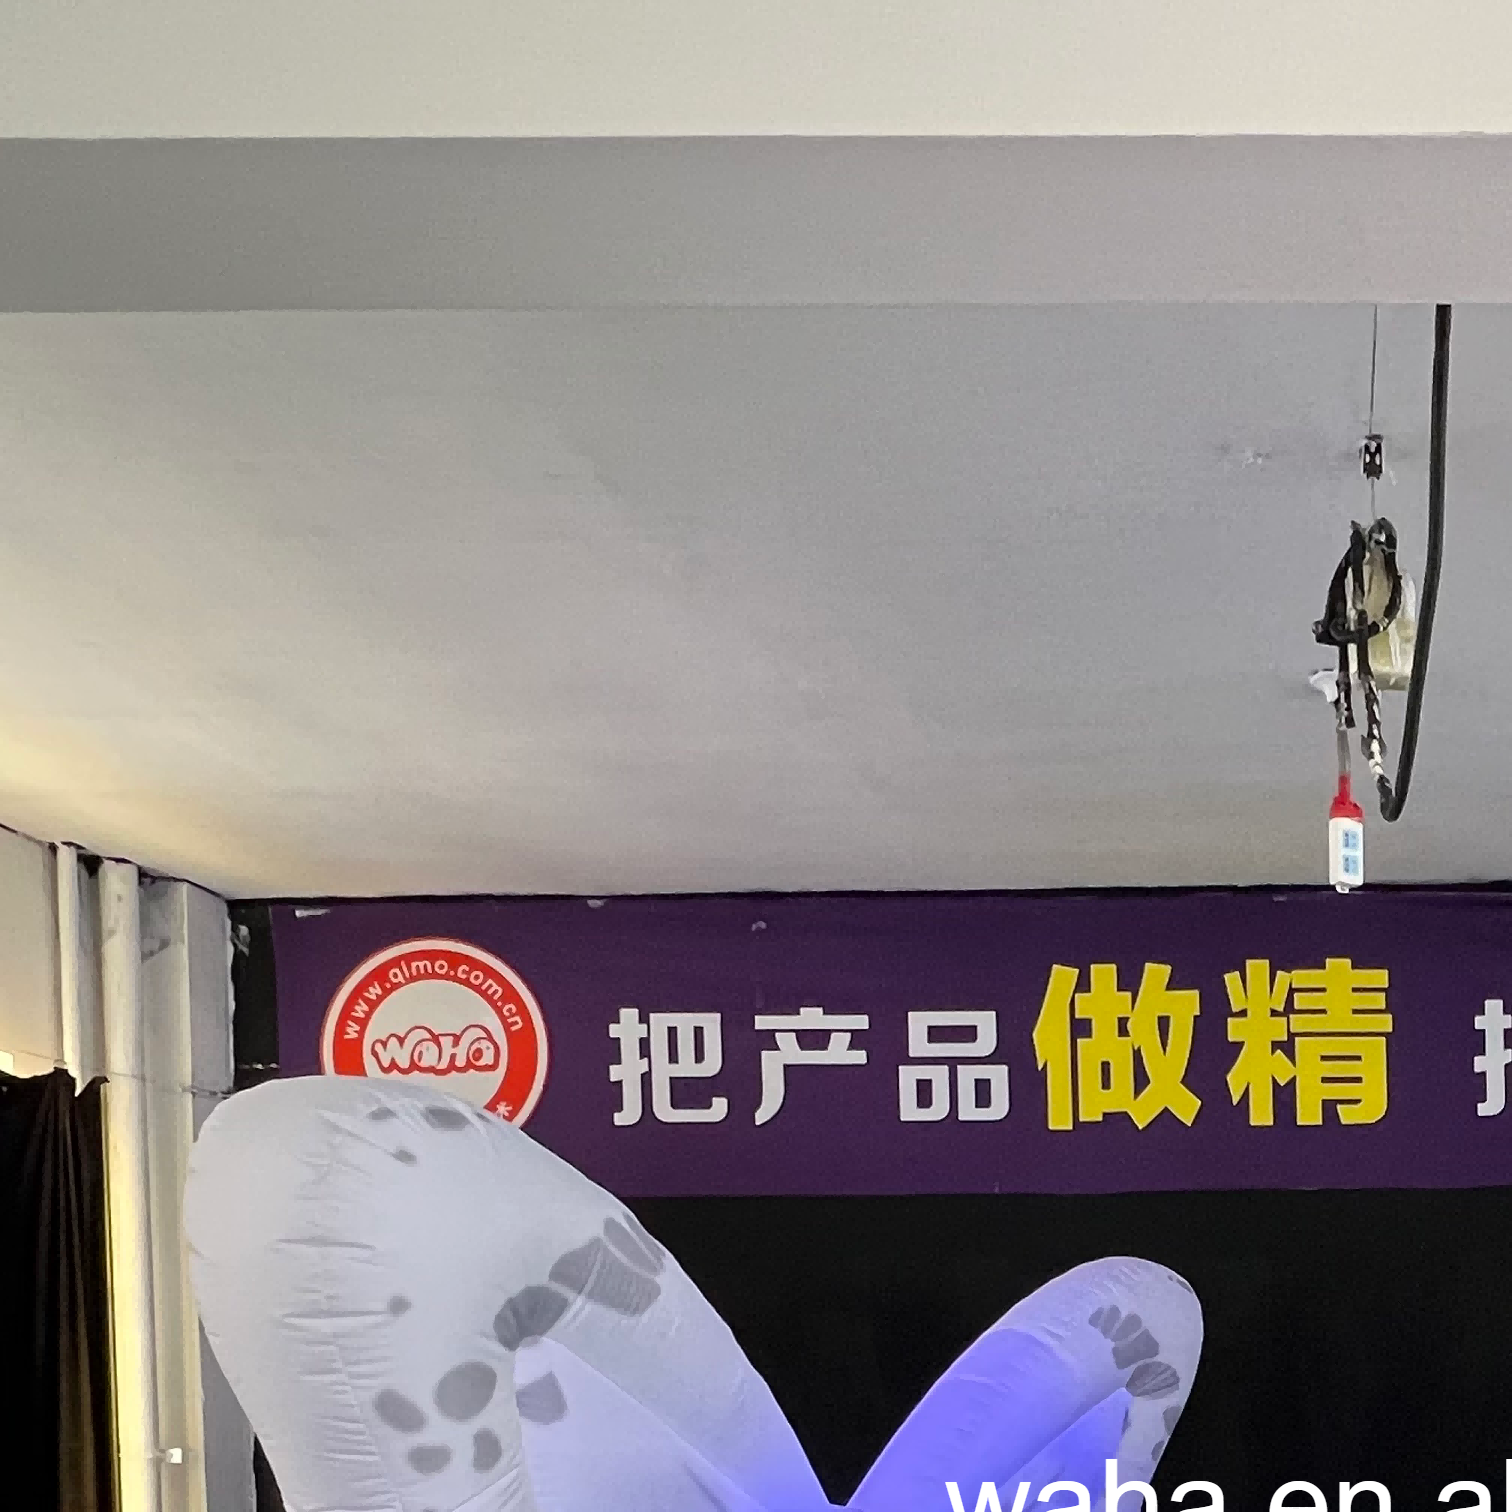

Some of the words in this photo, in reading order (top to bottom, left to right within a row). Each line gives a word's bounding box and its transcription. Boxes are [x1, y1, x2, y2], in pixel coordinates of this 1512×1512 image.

[608, 957, 1393, 1130] 把产品做精
